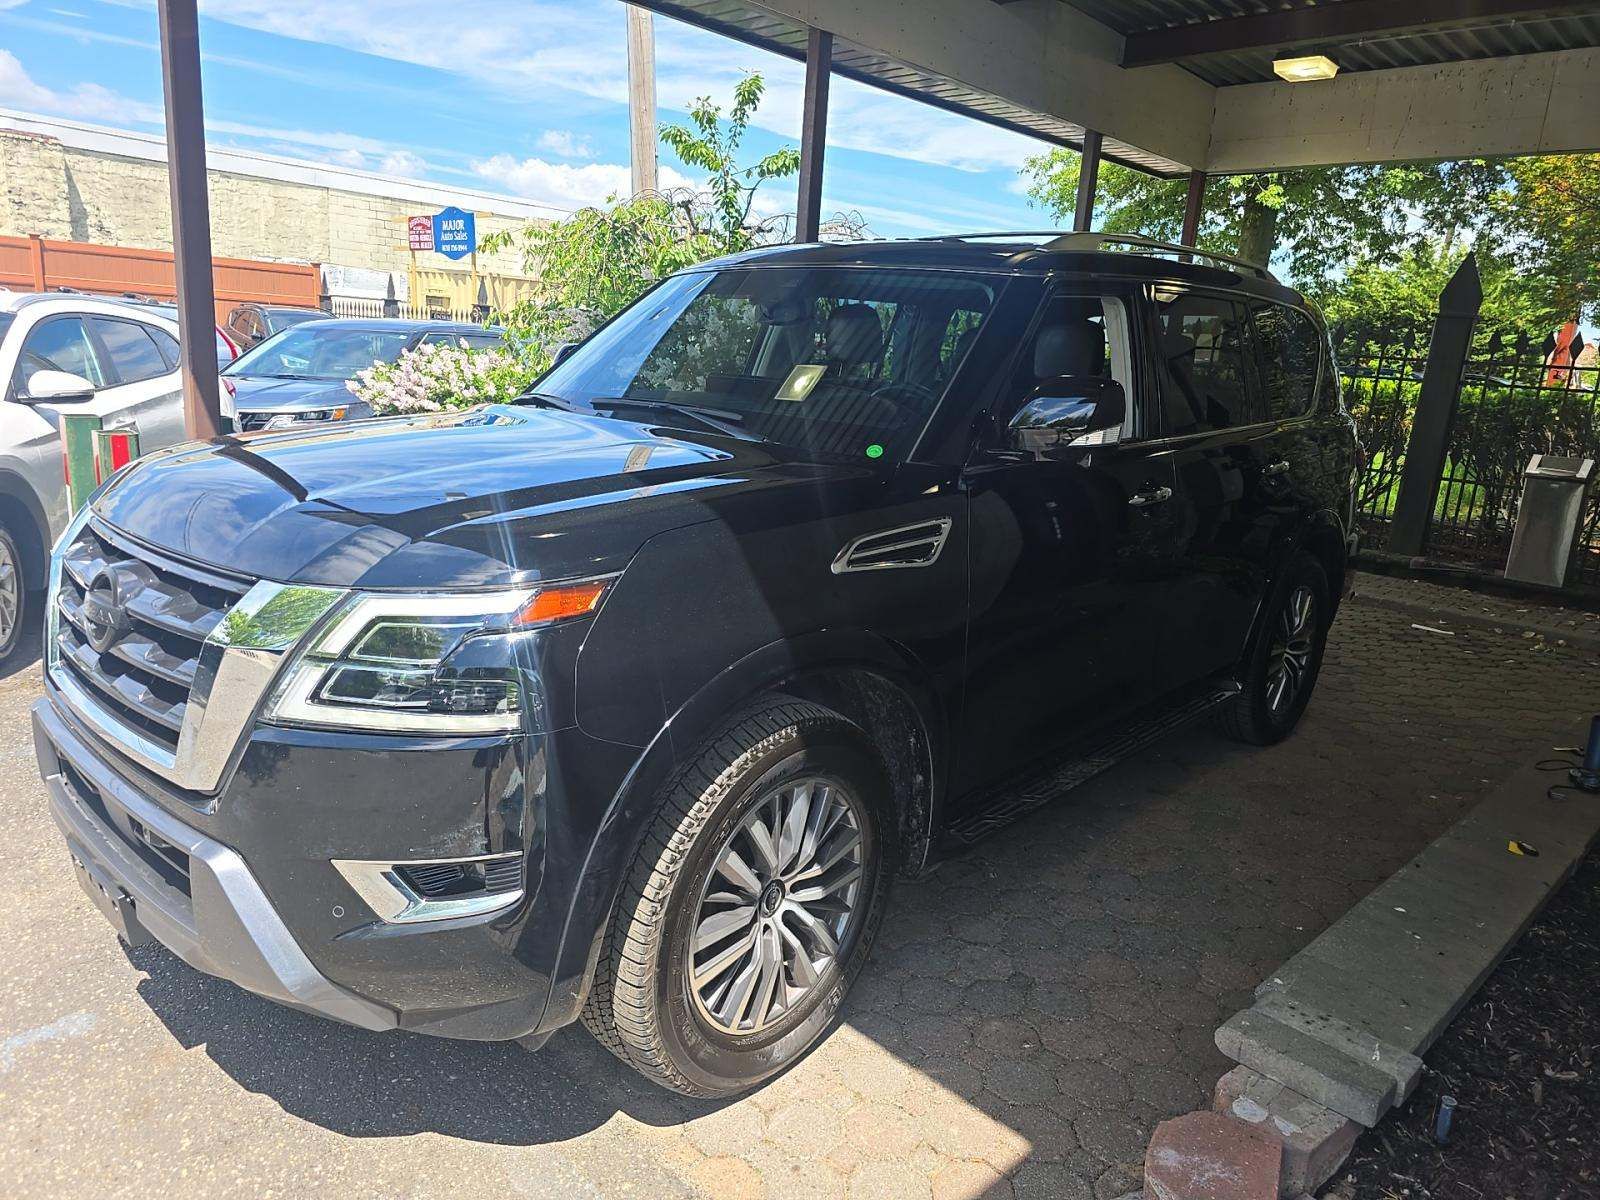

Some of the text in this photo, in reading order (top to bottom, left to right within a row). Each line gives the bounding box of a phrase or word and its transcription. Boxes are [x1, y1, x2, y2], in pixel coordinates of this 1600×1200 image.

[442, 220, 464, 230] MAJOR
[441, 232, 453, 240] Auto
[454, 231, 468, 240] Sales
